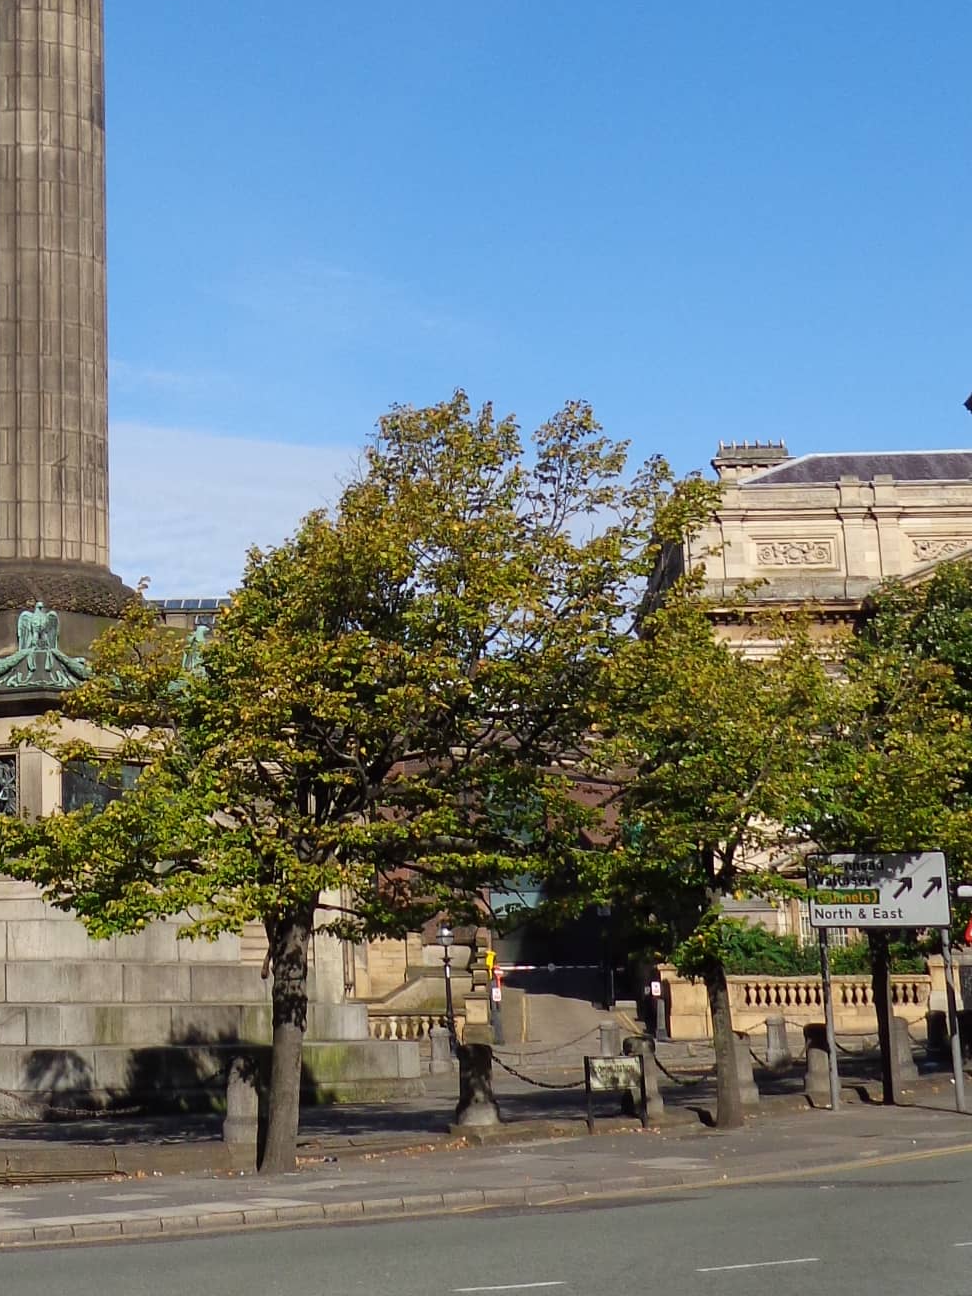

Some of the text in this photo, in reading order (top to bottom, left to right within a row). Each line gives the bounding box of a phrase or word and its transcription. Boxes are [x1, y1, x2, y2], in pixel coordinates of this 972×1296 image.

[817, 890, 878, 904] (unnels)
[814, 908, 904, 919] North & East
